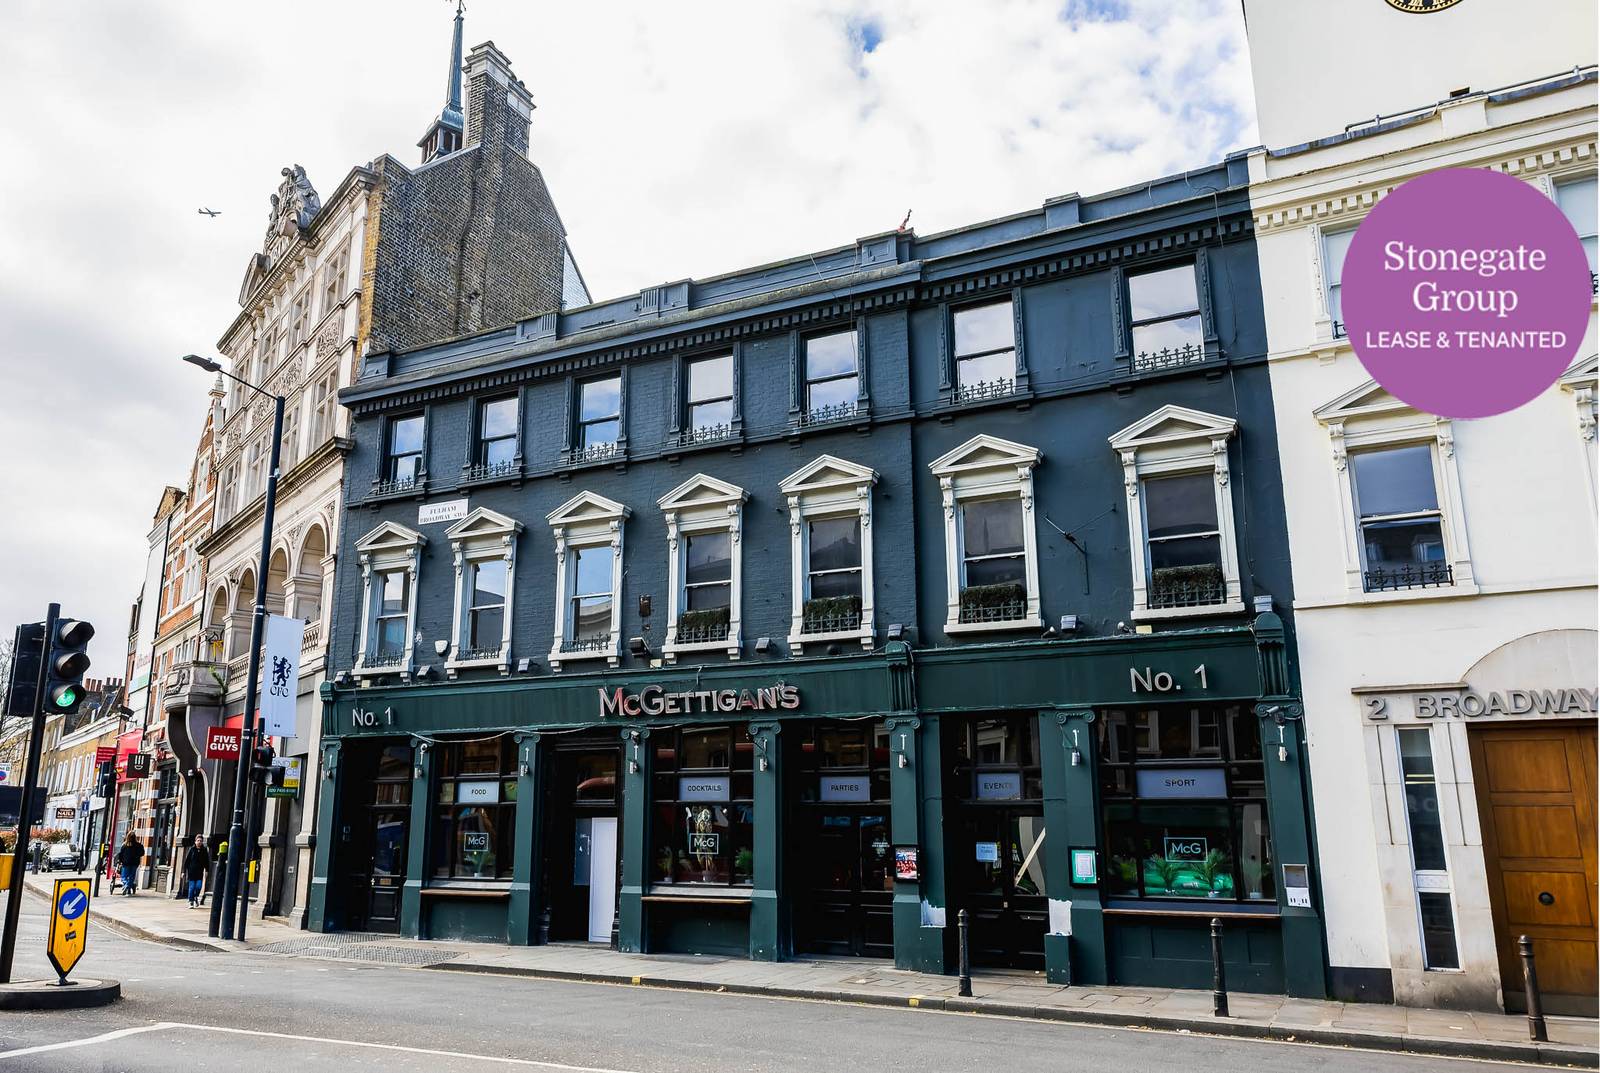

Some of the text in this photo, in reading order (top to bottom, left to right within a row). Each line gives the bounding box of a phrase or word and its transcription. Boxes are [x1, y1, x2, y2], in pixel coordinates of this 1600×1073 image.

[1130, 664, 1207, 692] No. 1
[270, 685, 289, 698] CFC
[1366, 696, 1388, 720] 2
[352, 706, 392, 727] No. 1
[213, 735, 237, 743] FIVE
[209, 742, 239, 751] GUYS
[1165, 779, 1197, 787] SPORT
[687, 784, 722, 792] COCKTAILS
[468, 836, 485, 845] McG
[694, 838, 715, 847] McG
[1171, 842, 1201, 854] McG
